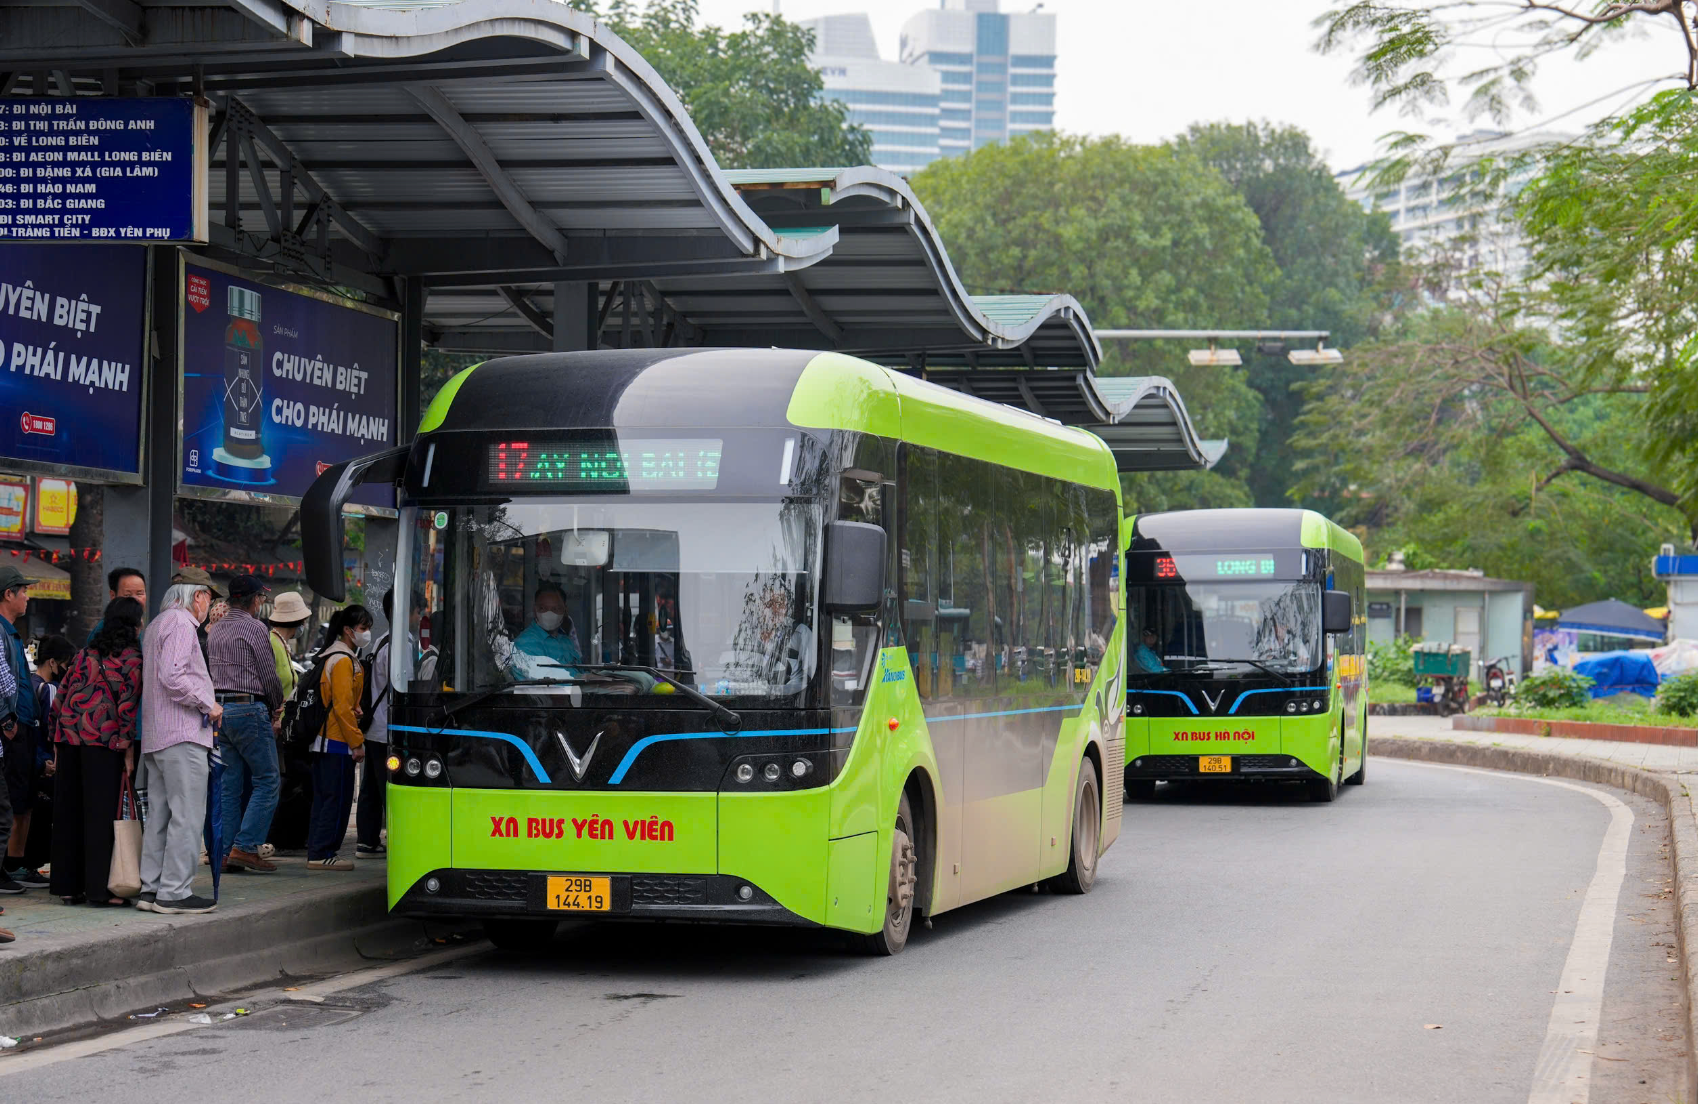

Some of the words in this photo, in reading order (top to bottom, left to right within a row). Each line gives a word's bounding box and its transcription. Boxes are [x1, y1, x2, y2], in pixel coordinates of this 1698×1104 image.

[13, 105, 28, 114] ĐI
[30, 103, 51, 116] NỘI
[56, 102, 76, 114] BÀI
[12, 121, 25, 130] ĐI
[29, 120, 48, 132] THỊ
[52, 117, 85, 130] TRẤN
[89, 118, 124, 130] ĐÔNG
[128, 120, 154, 130] ANH
[32, 136, 65, 146] LONG
[69, 134, 98, 145] BIÊN
[13, 152, 25, 162] ĐI
[29, 152, 63, 161] AEON
[67, 152, 101, 161] MALL
[105, 152, 138, 161] LONG
[142, 149, 172, 161] BIÊN
[20, 168, 32, 177] ĐI
[36, 166, 71, 179] ĐẶNG
[76, 165, 92, 176] XÁ
[97, 167, 122, 177] (GIA
[127, 165, 158, 177] LÂM)
[0, 184, 17, 193] 46:
[20, 184, 33, 193] ĐI
[37, 180, 62, 193] HÀO
[67, 184, 96, 193] NAM
[20, 200, 32, 209] ĐI
[37, 196, 62, 209] BẮC
[66, 199, 105, 209] GIANG
[16, 215, 60, 224] SMART
[64, 215, 91, 224] CITY
[12, 226, 50, 237] TRÀNG
[92, 228, 116, 237] BĐX
[120, 225, 143, 237] YÊN
[146, 228, 170, 239] PHỤ
[53, 293, 101, 338] BIỆT
[10, 341, 64, 380] PHÁI
[68, 354, 130, 394] MẠNH
[272, 351, 333, 388] CHUYÊN
[336, 362, 368, 399] BIỆT
[272, 398, 305, 427] CHO
[308, 404, 344, 434] PHÁI
[347, 413, 389, 445] MẠNH
[498, 443, 528, 479] 17
[1217, 560, 1256, 574] LONG
[1191, 731, 1211, 741] BUS
[1215, 728, 1230, 741] HÀ
[1233, 728, 1255, 744] NỘI
[490, 816, 519, 838] XN
[527, 817, 565, 840] BUS
[572, 813, 615, 840] YÊN
[622, 815, 674, 842] VIÊN
[564, 879, 592, 892] 29B
[555, 894, 603, 910] 144.19
